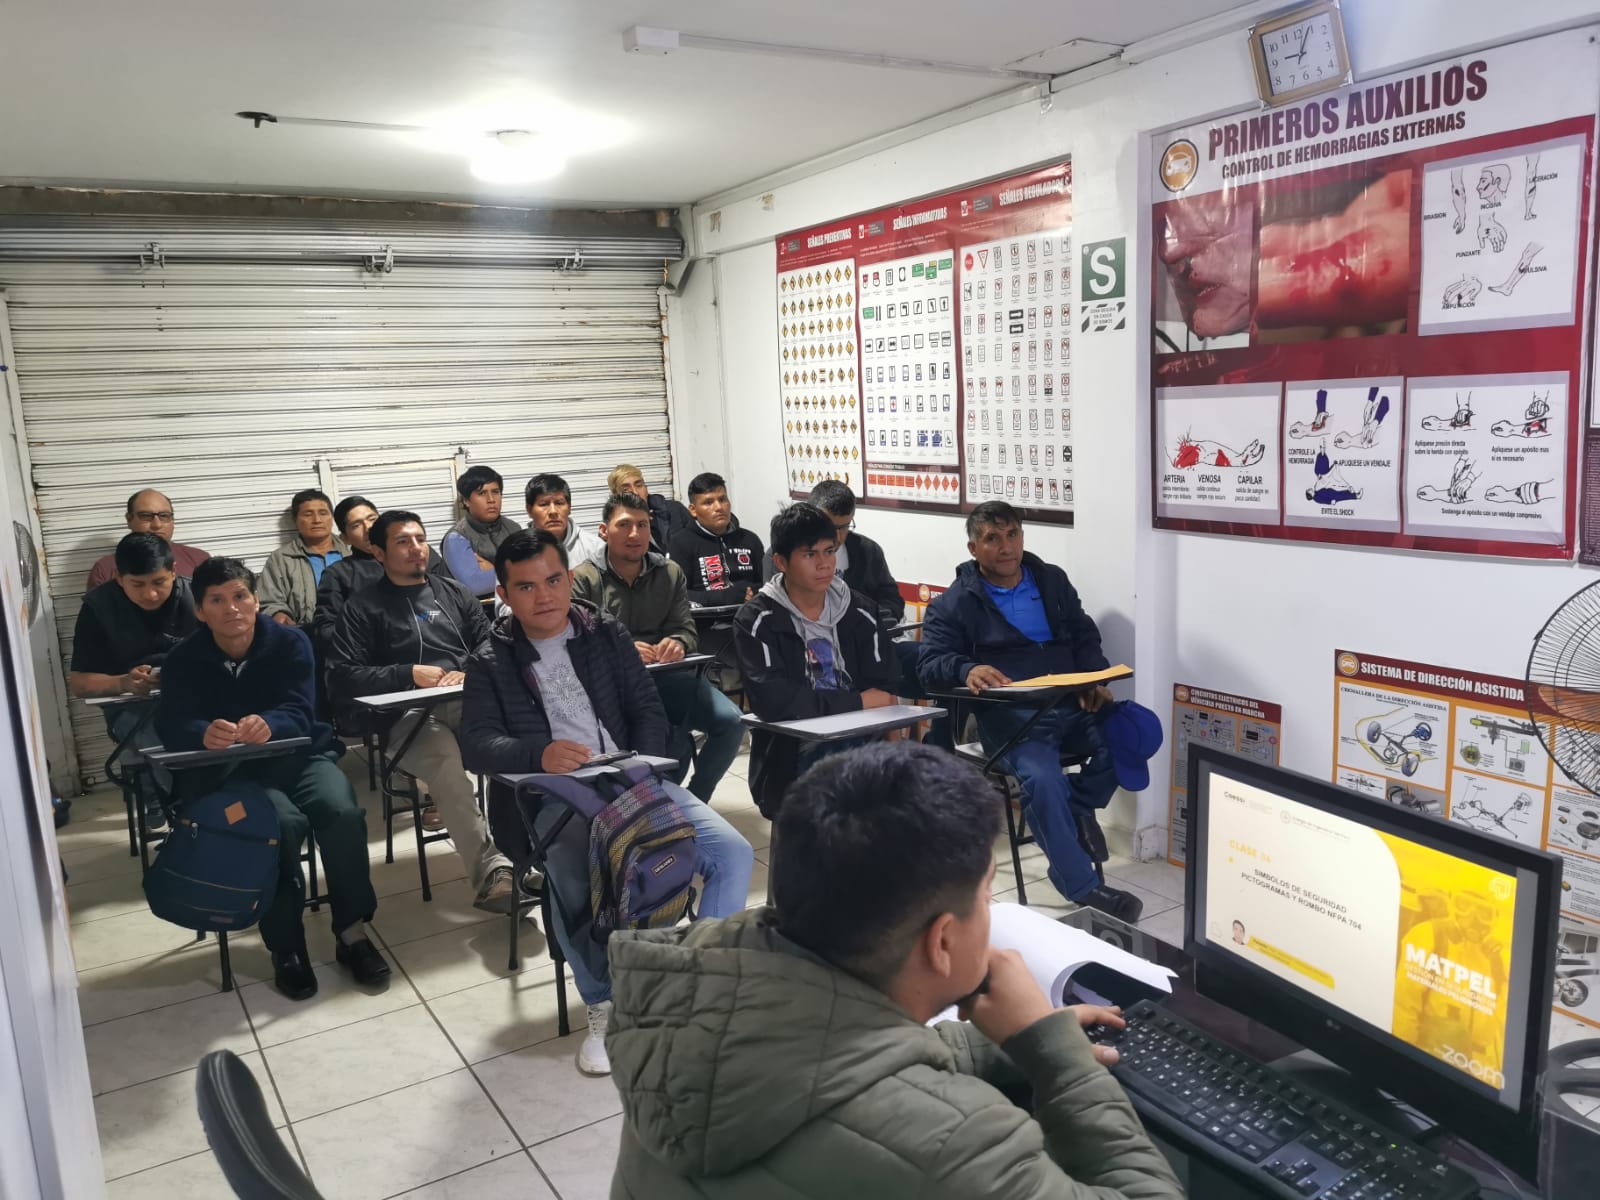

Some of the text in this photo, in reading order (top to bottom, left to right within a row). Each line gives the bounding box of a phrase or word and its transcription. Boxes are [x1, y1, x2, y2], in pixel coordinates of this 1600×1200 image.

[1293, 28, 1303, 40] 12
[1321, 24, 1328, 35] 2
[1281, 33, 1289, 44] 11
[1269, 42, 1278, 53] 10
[1324, 41, 1332, 52] 3
[1271, 60, 1278, 69] 9
[1327, 59, 1334, 69] 4
[1275, 76, 1282, 86] 8
[1289, 74, 1296, 88] 7
[1302, 70, 1310, 80] 6
[1208, 60, 1487, 161] PRIMEROS AUXILIOS
[1222, 111, 1466, 179] CONTROL DE HEMORRAGIAS EXTERNAS
[1090, 246, 1116, 294] S
[1163, 474, 1263, 484] ARTERIA VENOSA CAPILAR
[1361, 662, 1525, 702] SISTEMA DE DIRECCIÓN ASISTIDA
[1229, 839, 1256, 857] CLASE
[1241, 872, 1290, 899] PICTOGRAMAS
[1298, 896, 1326, 914] ROMBO
[1327, 910, 1348, 924] NFPA
[1292, 884, 1301, 894] DE
[1303, 890, 1347, 914] SEGURIDAD
[1406, 943, 1497, 1000] MATPEL
[1441, 1044, 1505, 1090] zoom
